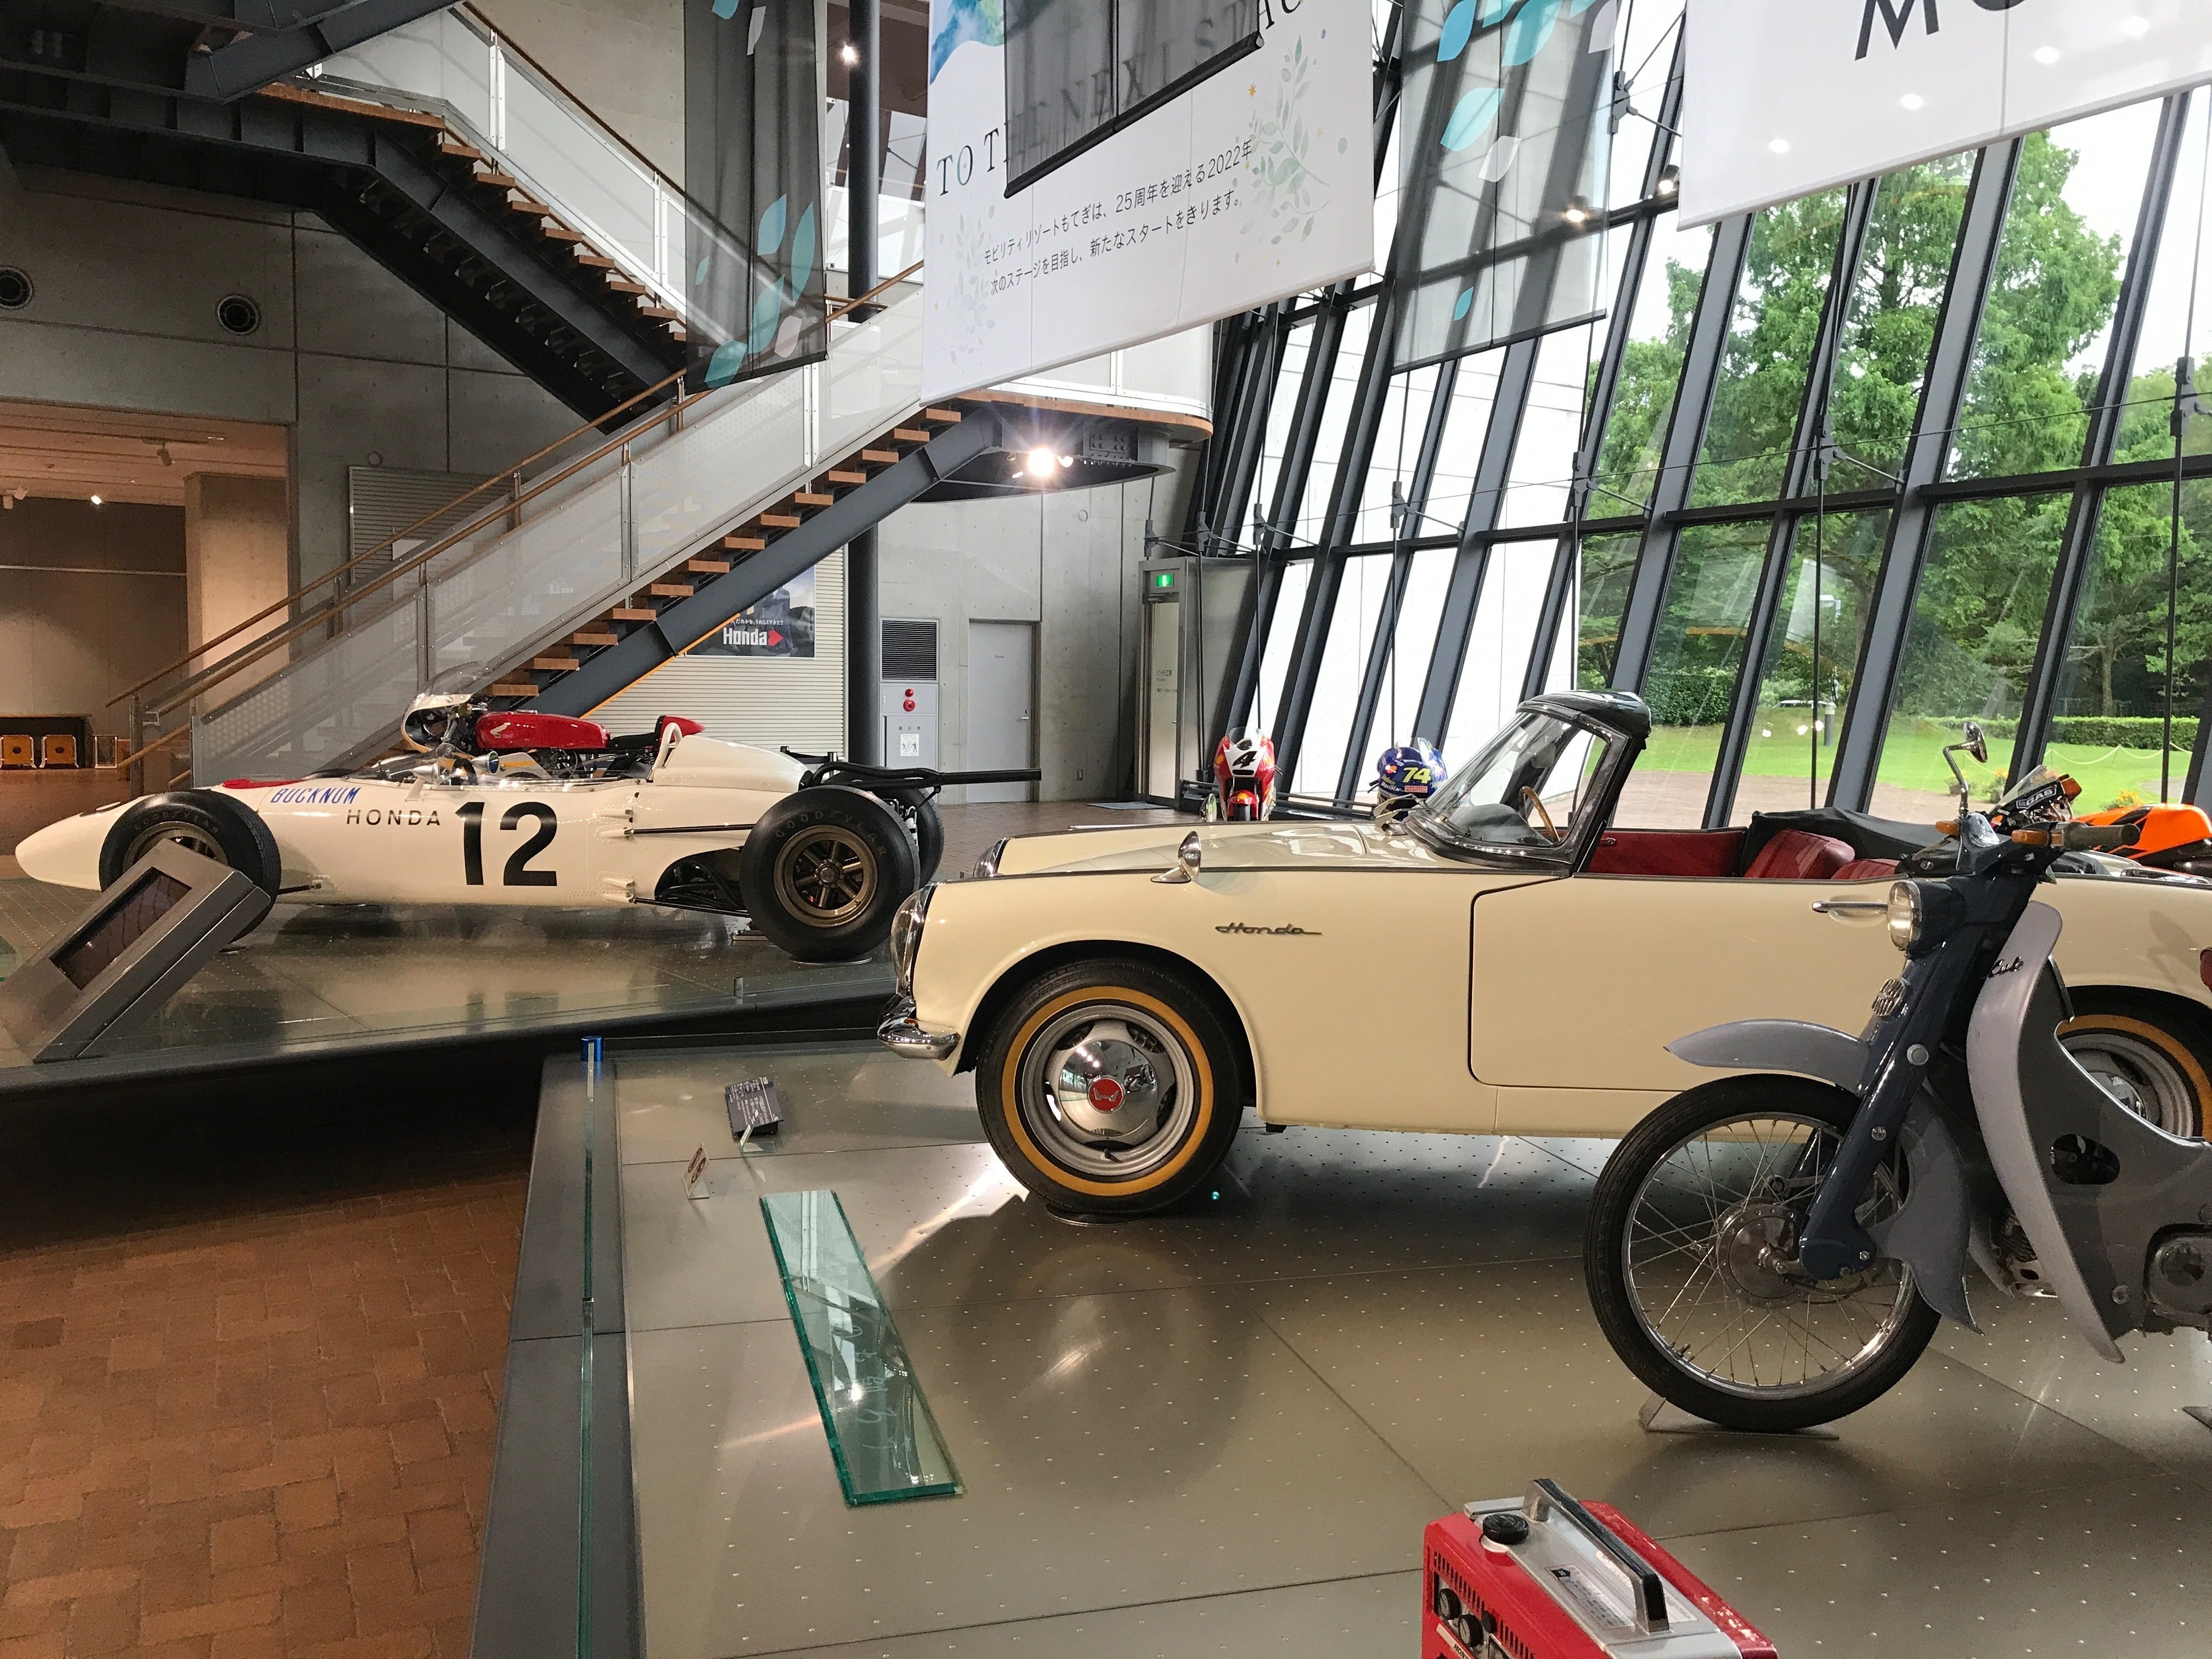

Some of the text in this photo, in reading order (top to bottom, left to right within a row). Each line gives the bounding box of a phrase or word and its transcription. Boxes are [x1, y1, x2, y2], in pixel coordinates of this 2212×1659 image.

[936, 145, 973, 195] TO
[723, 628, 767, 645] Honda
[1232, 751, 1258, 769] 4
[1402, 767, 1431, 784] 74
[270, 787, 361, 804] BUCKNUM
[346, 809, 441, 826] HONDA
[455, 802, 558, 887] 12
[1215, 922, 1323, 934] Honda
